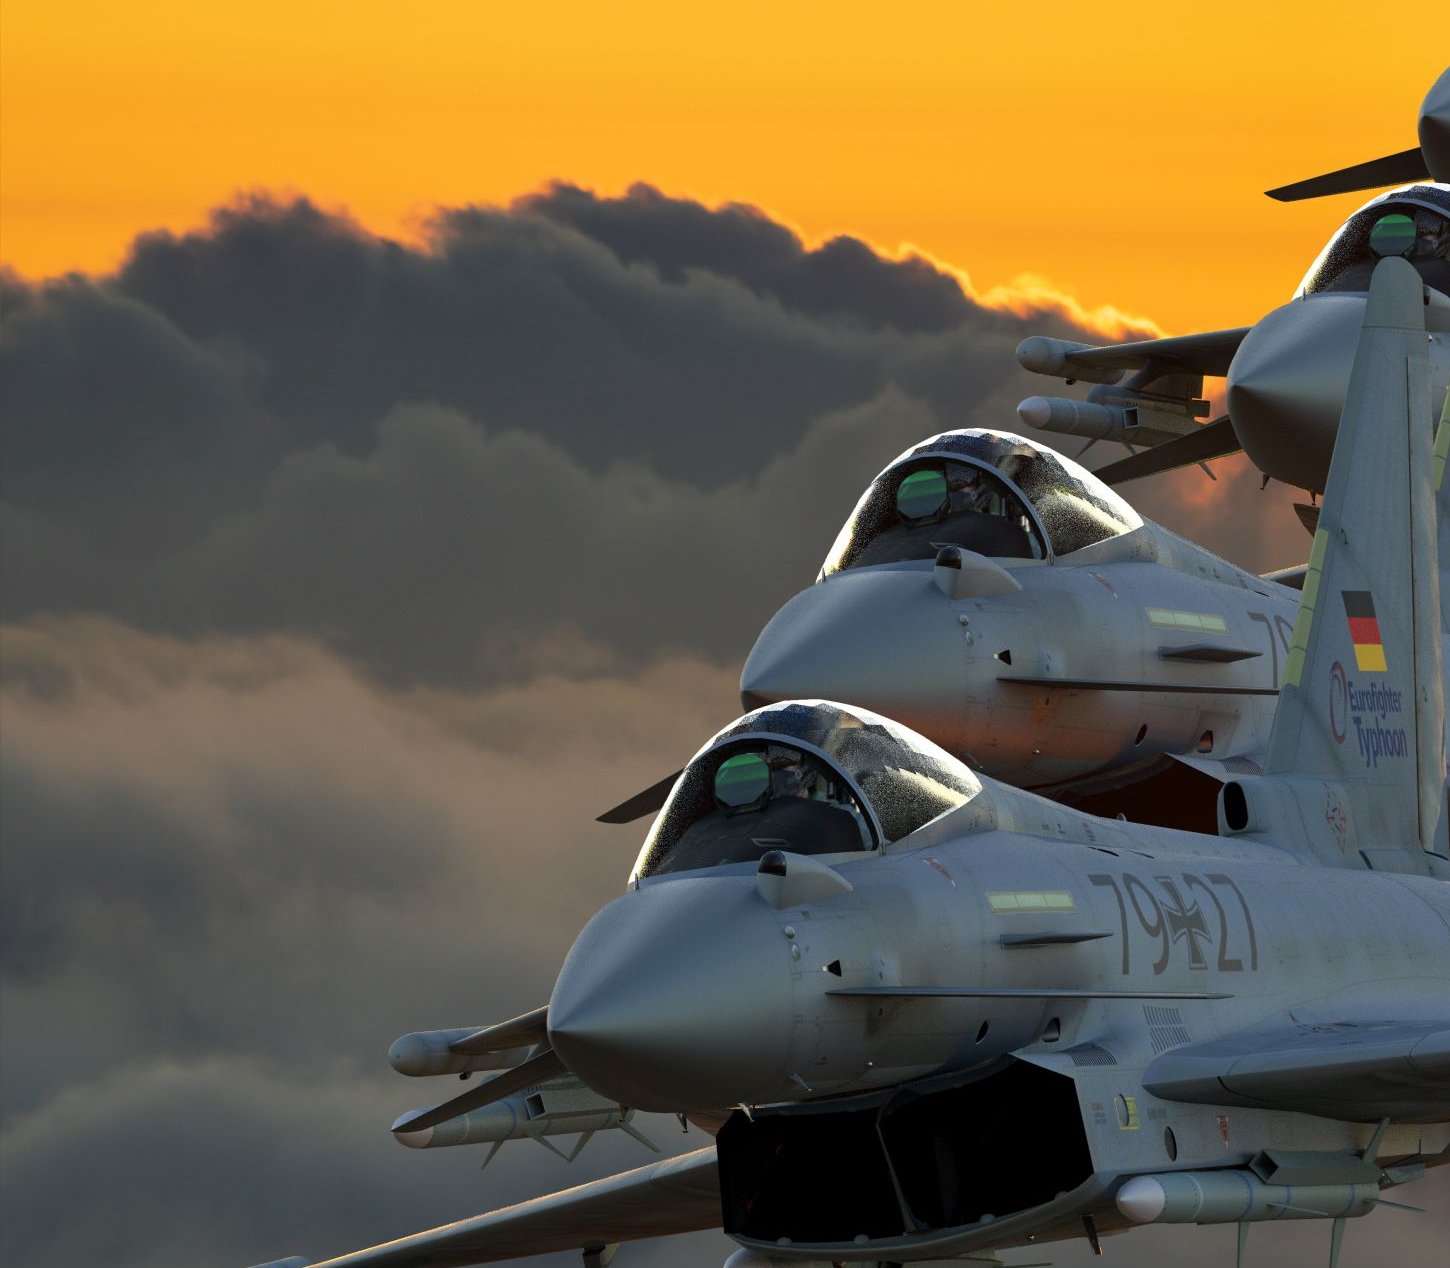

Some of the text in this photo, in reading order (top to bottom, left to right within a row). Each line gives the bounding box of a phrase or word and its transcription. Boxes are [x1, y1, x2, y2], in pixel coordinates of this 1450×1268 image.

[1347, 680, 1402, 719] Eurofighter
[1352, 716, 1408, 768] Typhoon
[1087, 872, 1258, 976] 79 27
